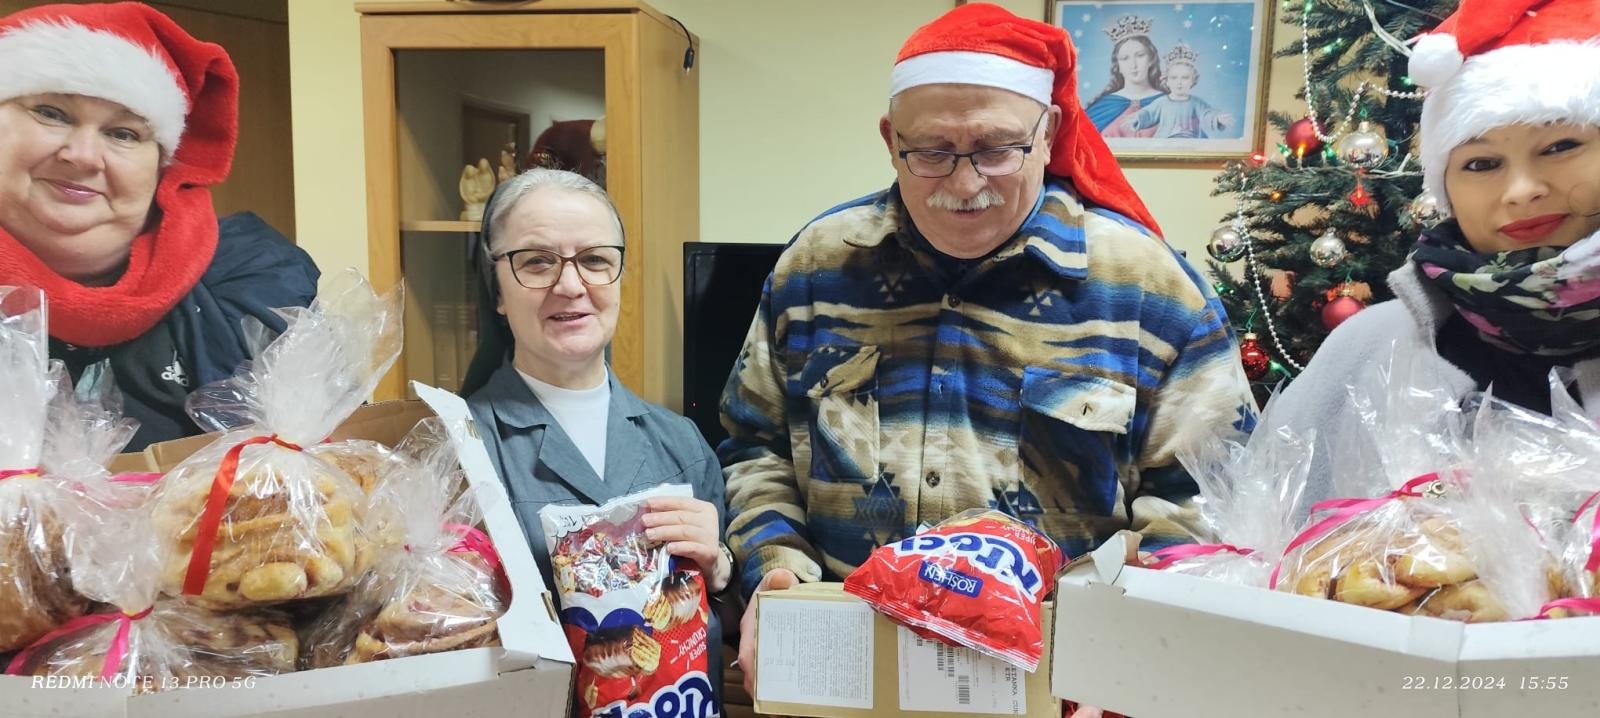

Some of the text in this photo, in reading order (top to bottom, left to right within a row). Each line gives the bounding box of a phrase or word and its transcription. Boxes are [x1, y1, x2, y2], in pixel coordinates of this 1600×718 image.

[924, 563, 977, 593] ROSHEN
[678, 627, 707, 657] CRUNCHY
[689, 641, 707, 661] SUPER
